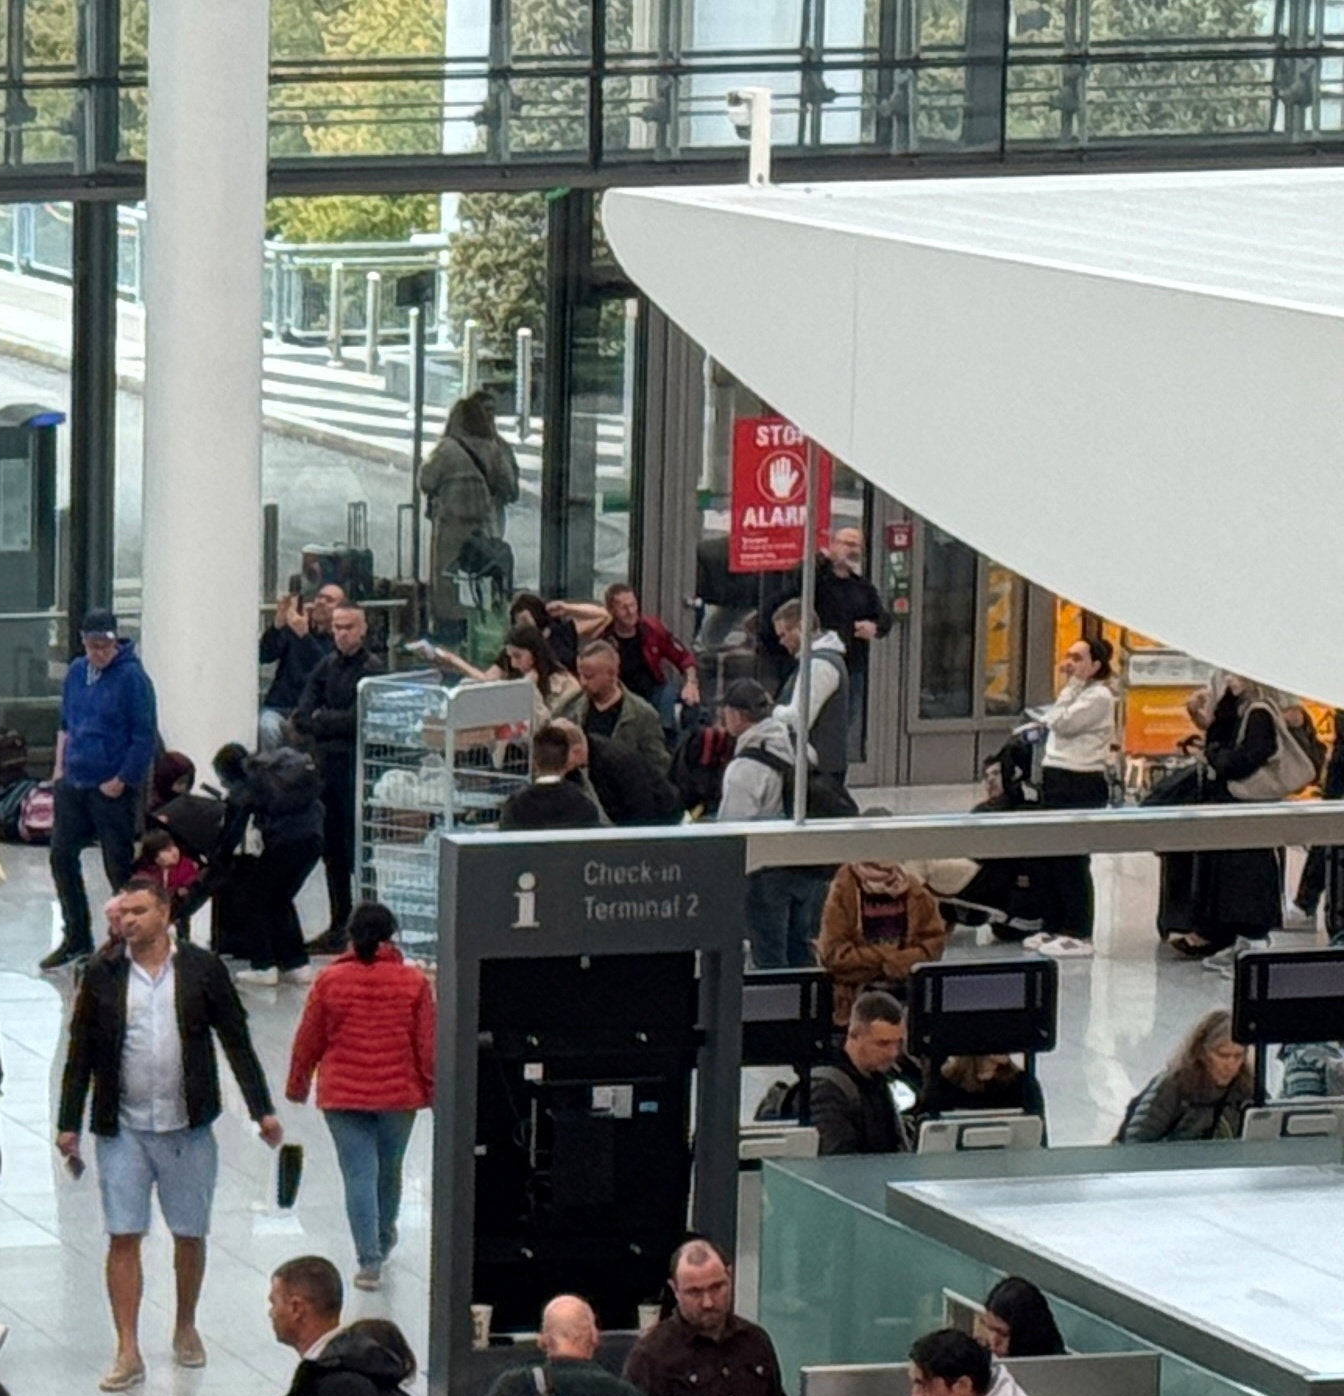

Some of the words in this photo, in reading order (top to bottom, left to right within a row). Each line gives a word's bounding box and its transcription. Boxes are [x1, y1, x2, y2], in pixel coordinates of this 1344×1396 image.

[584, 859, 681, 885] Check-in
[584, 893, 681, 920] Terminal
[686, 891, 700, 917] 2
